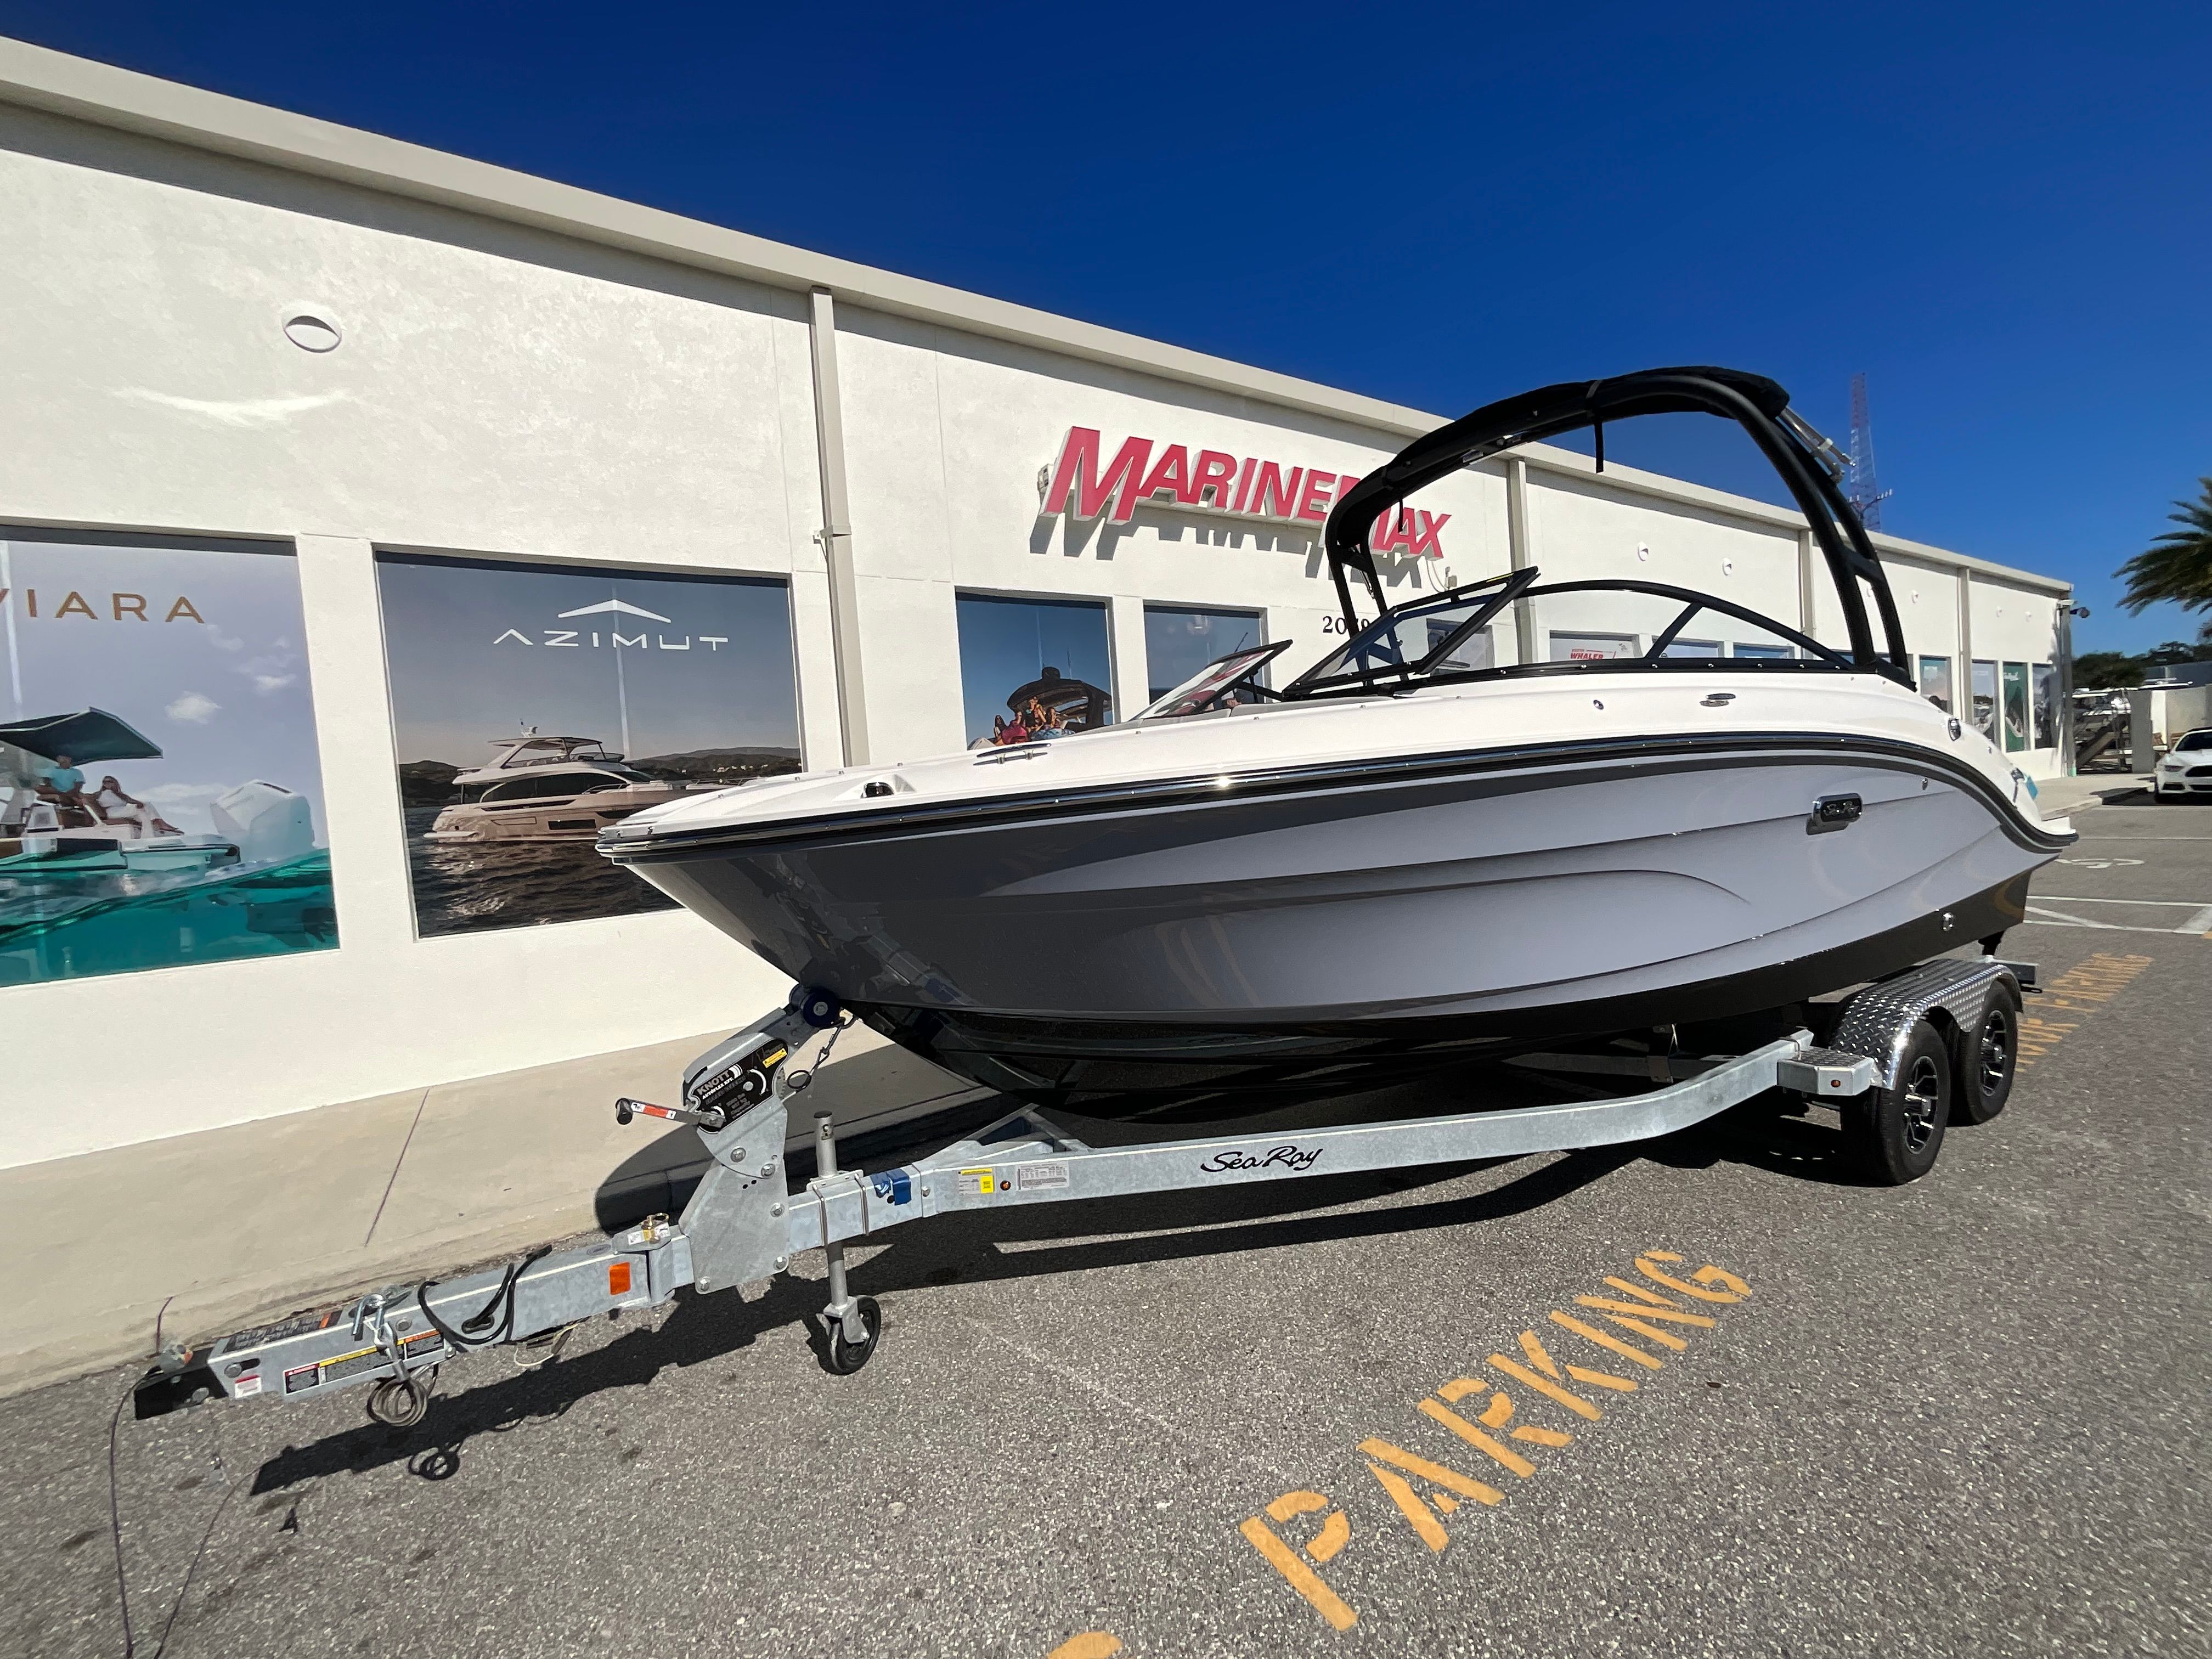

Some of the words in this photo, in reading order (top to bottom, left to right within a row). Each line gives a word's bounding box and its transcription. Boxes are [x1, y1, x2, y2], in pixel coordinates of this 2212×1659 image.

[493, 628, 729, 652] AZIMUT
[697, 1070, 730, 1095] KNOTT
[1200, 1151, 1264, 1173] Sea
[1261, 1146, 1323, 1171] Ray
[1239, 1249, 1752, 1632] PARKING
